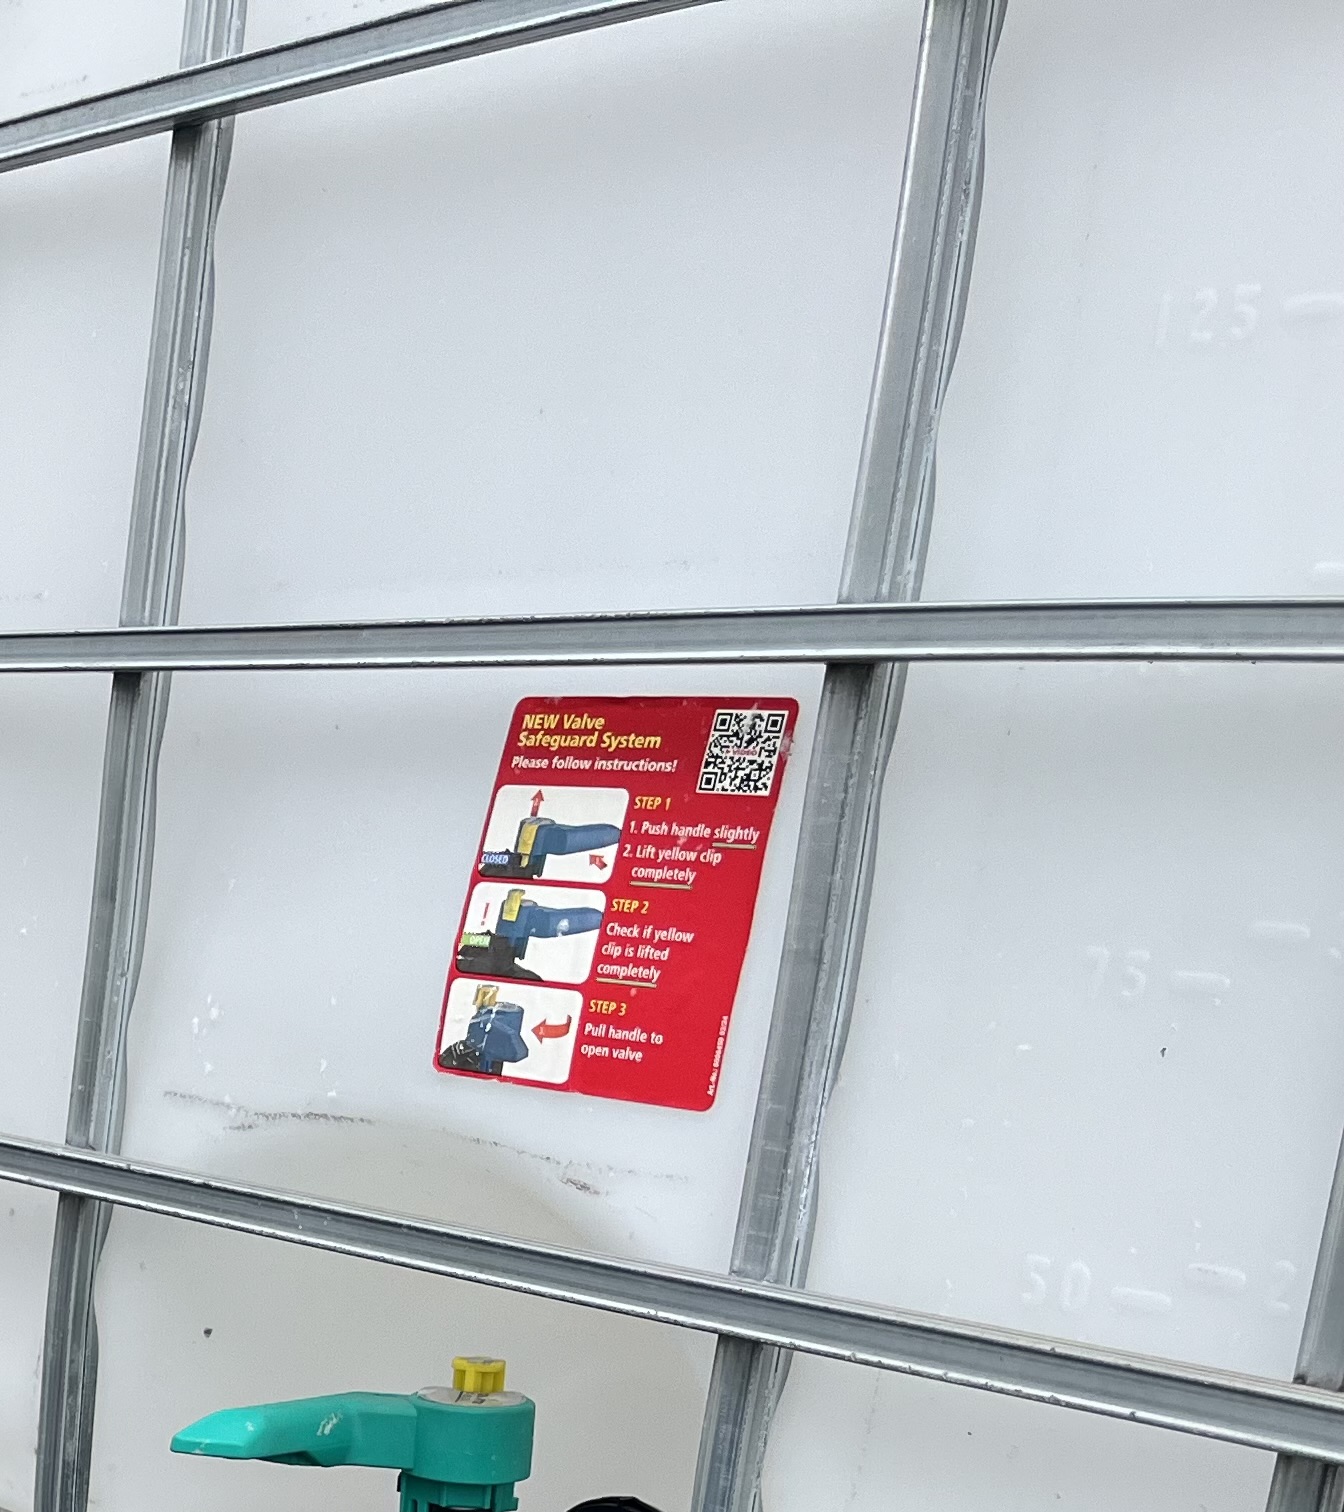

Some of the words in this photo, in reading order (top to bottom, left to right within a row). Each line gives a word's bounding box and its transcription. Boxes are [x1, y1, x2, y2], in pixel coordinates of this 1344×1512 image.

[522, 714, 560, 729] NEW
[563, 713, 605, 729] Valve
[518, 731, 599, 750] Safeguard
[600, 732, 662, 752] System
[511, 755, 549, 769] Please
[551, 755, 592, 770] follow
[594, 756, 678, 772] instructions!
[633, 796, 662, 810] STEP
[665, 797, 671, 811] 1
[629, 820, 638, 834] 1.
[640, 821, 668, 836] Push
[670, 822, 711, 838] handle
[713, 825, 760, 844] slightly
[623, 844, 633, 858] 2.
[635, 844, 656, 859] Lift
[657, 846, 698, 863] yellow
[699, 849, 722, 867] clip
[631, 865, 696, 885] completely
[611, 898, 639, 913] STEP
[640, 900, 649, 914] 2
[606, 922, 641, 938] Check
[642, 925, 654, 939] if
[653, 927, 695, 943] yellow
[601, 941, 622, 959] clip
[624, 943, 634, 957] is
[636, 944, 671, 961] lifted
[596, 962, 662, 984] completely
[588, 999, 617, 1015] STEP
[618, 1002, 627, 1016] 3
[584, 1022, 607, 1038] Pull
[608, 1024, 648, 1043] handle
[650, 1031, 664, 1045] to
[580, 1044, 610, 1059] open
[612, 1046, 643, 1063] valve
